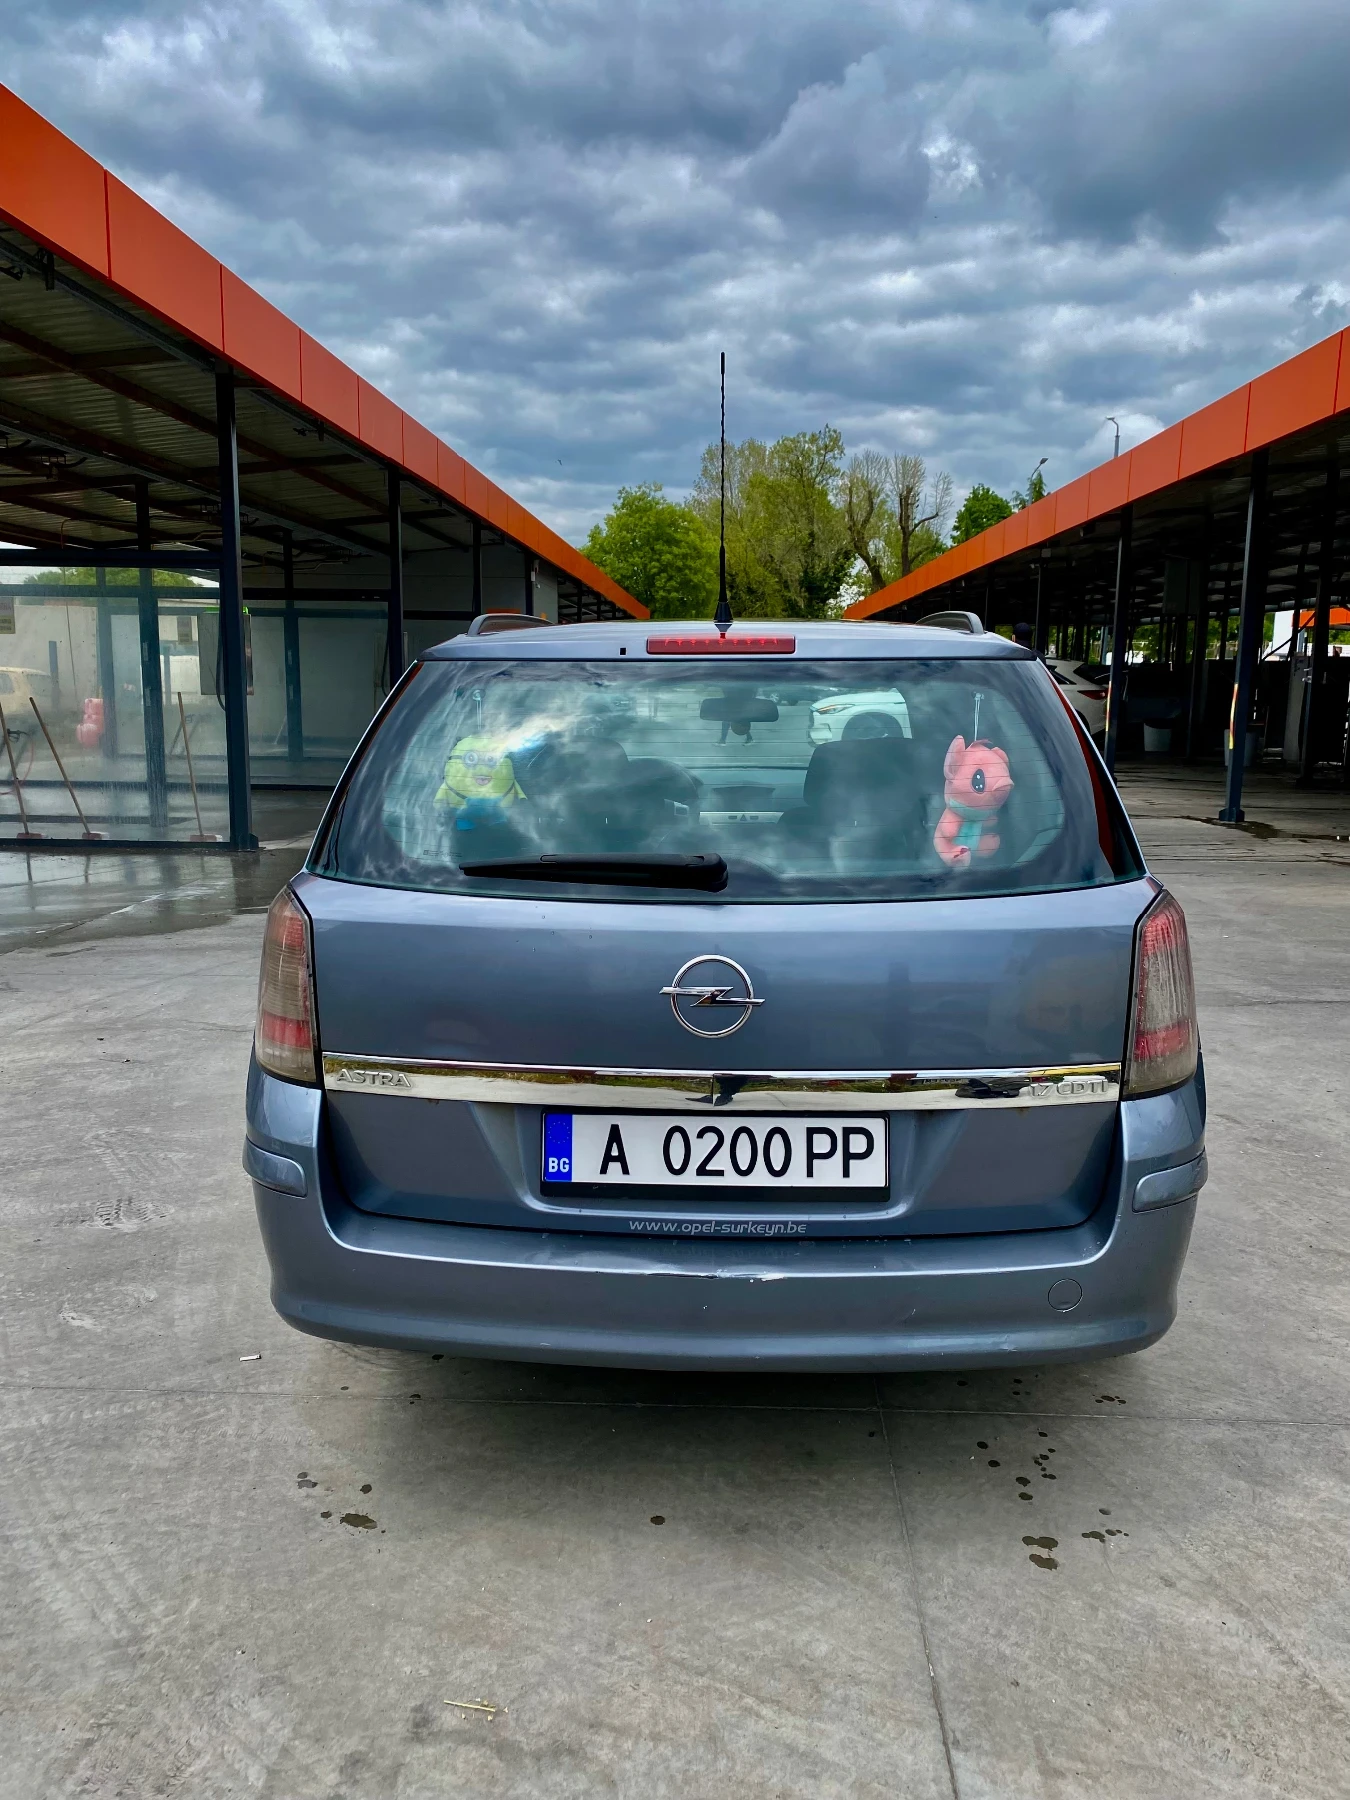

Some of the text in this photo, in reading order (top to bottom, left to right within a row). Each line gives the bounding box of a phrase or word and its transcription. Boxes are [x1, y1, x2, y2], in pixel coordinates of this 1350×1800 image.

[337, 1068, 411, 1088] ASTRA
[1057, 1079, 1109, 1095] CDTI
[599, 1123, 630, 1175] A
[548, 1157, 570, 1173] BG
[629, 1219, 807, 1236] www.opel-surkeyn.be
